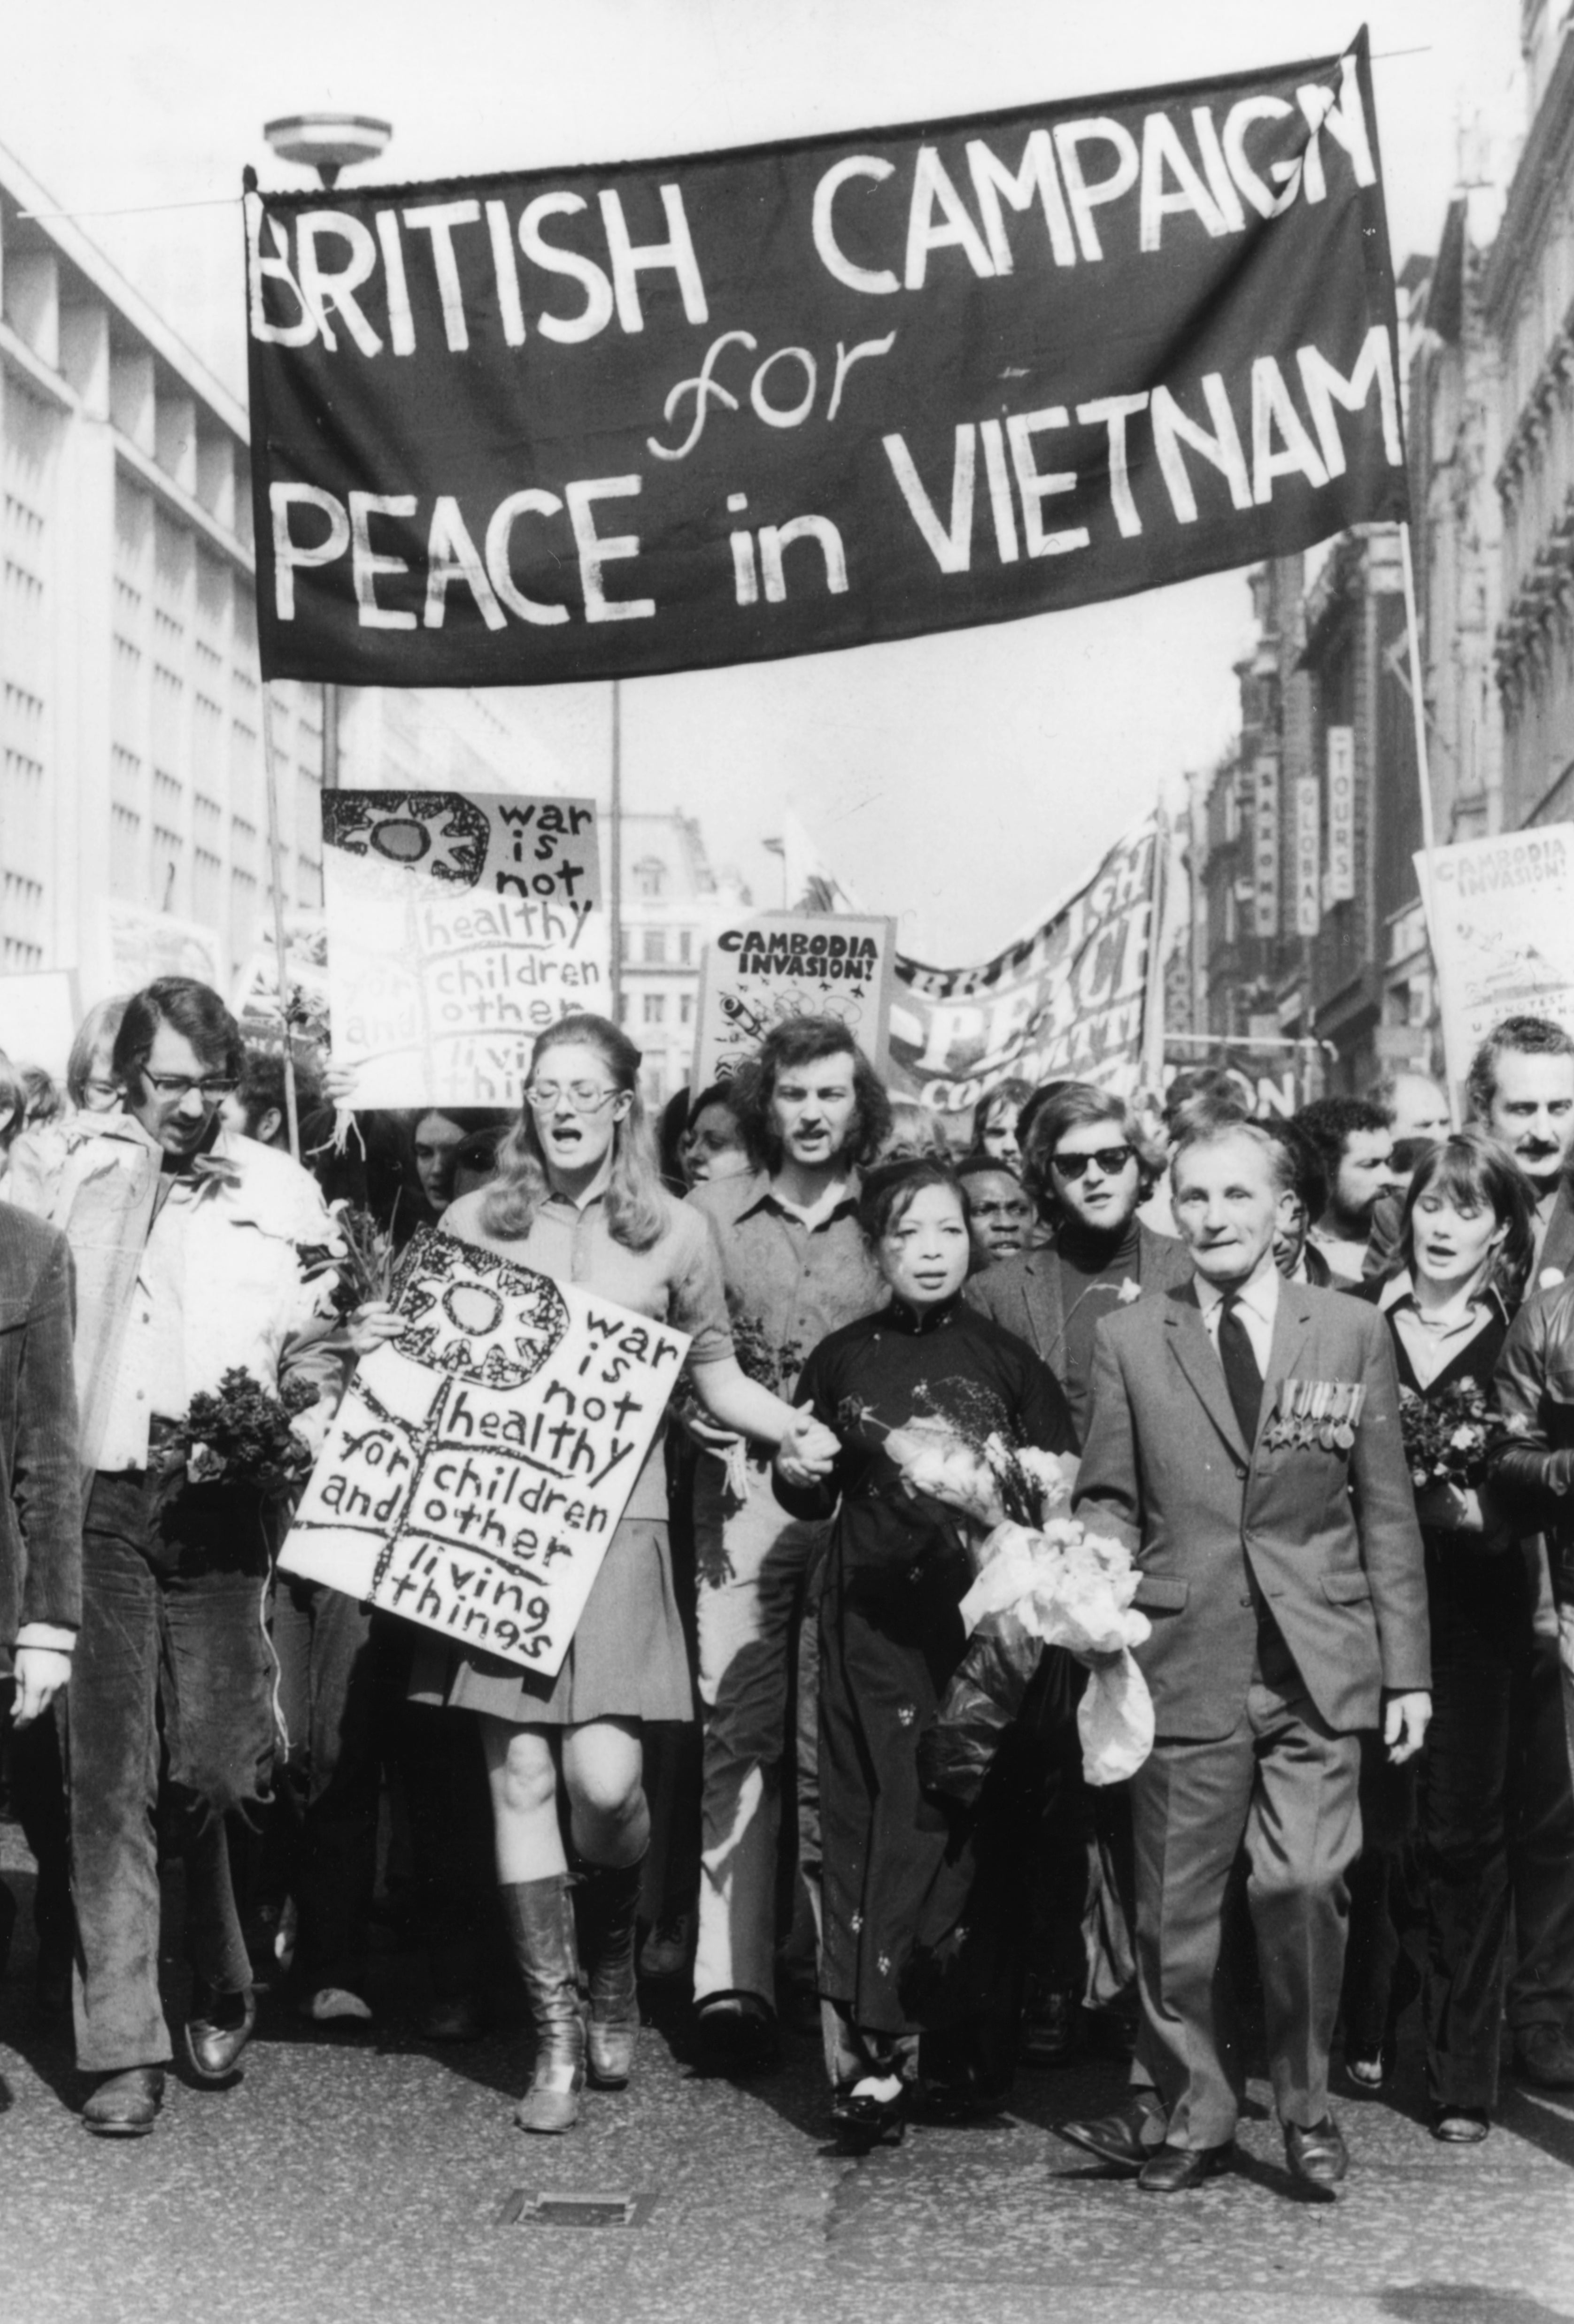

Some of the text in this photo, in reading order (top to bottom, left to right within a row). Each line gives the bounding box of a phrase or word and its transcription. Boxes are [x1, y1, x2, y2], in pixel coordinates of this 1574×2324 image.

[245, 54, 1376, 358] BRITISH CAMPAIGN
[647, 331, 896, 460] for
[269, 324, 1403, 631] PEACE in VIETNAM
[498, 804, 593, 835] war
[512, 829, 558, 862] is
[1435, 839, 1566, 882] CAMBODIA
[496, 860, 584, 897] not
[1457, 858, 1566, 898] INVASION!
[426, 900, 593, 949] healthy
[718, 930, 878, 959] CAMBODIA
[437, 954, 600, 995] children
[739, 953, 874, 981] INVASION!
[452, 1038, 525, 1071] livi
[578, 1342, 631, 1383] is
[586, 1311, 677, 1368] war
[544, 1380, 643, 1430] not
[447, 1392, 634, 1488] healthy
[320, 1475, 573, 1566] and other
[433, 1457, 608, 1535] children
[409, 1543, 550, 1634] living
[391, 1574, 552, 1658] things
